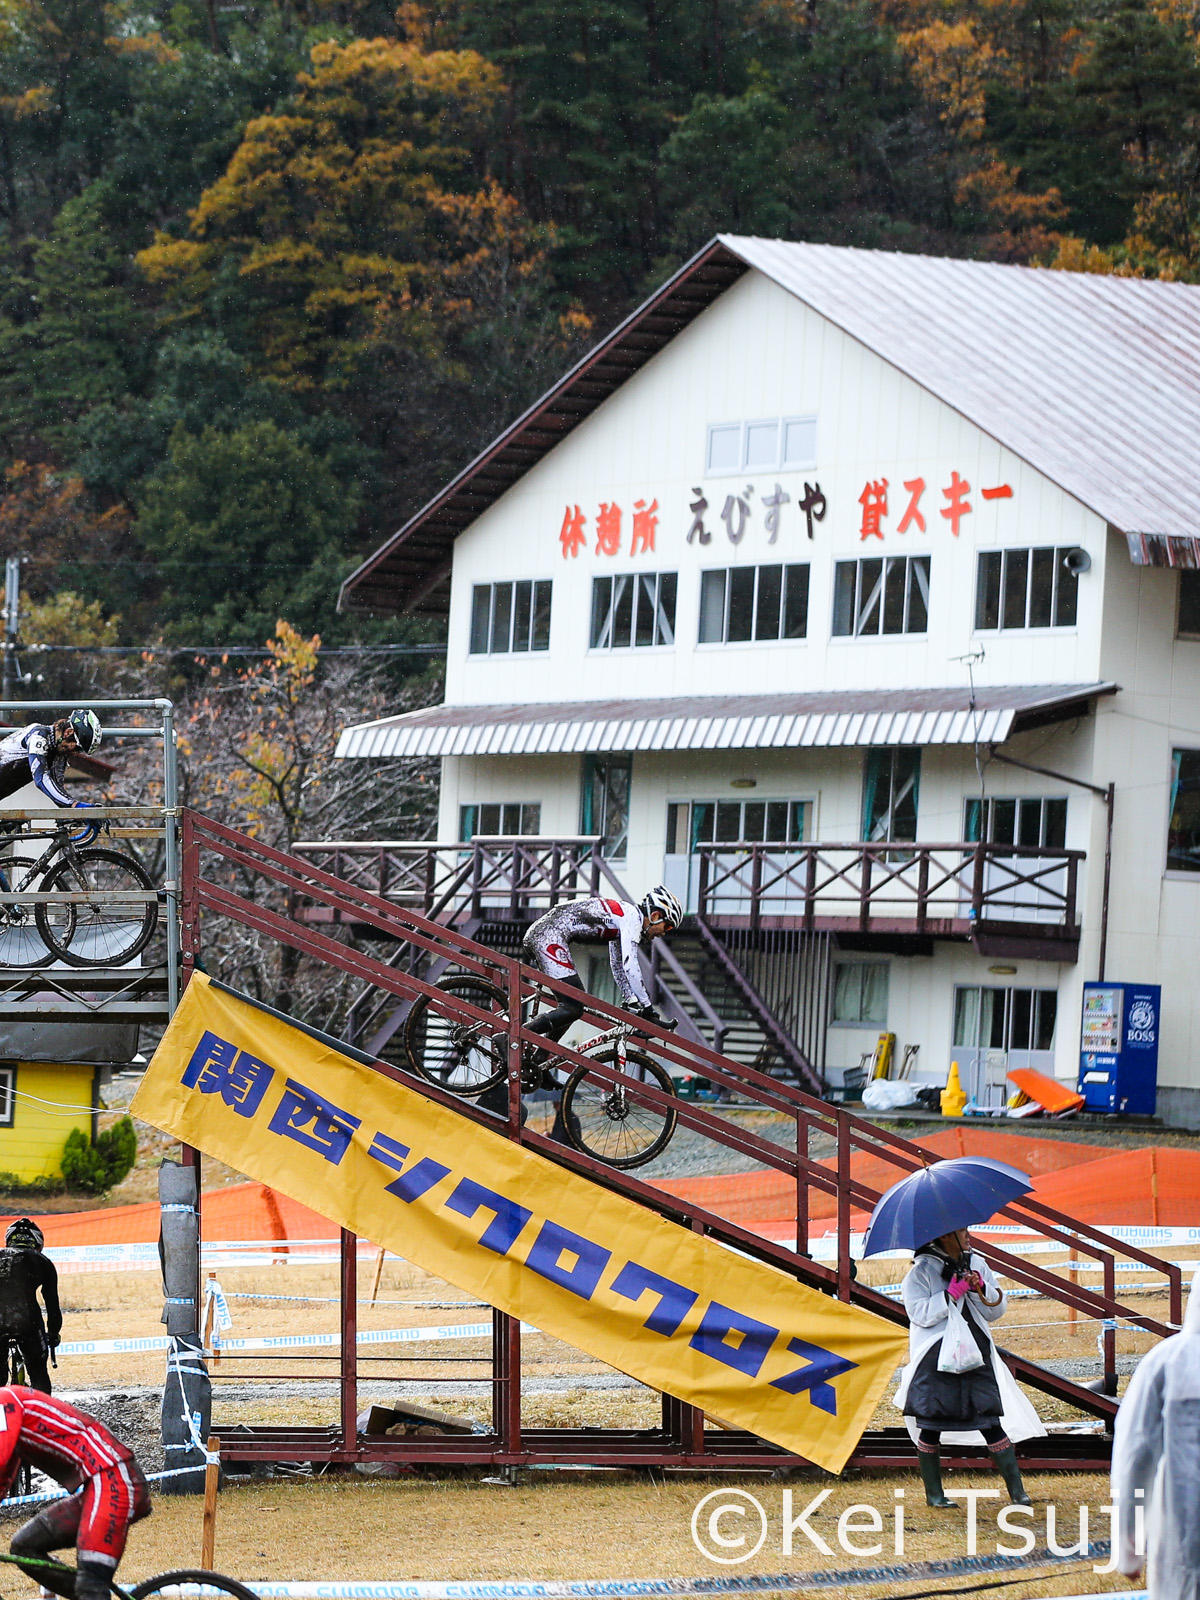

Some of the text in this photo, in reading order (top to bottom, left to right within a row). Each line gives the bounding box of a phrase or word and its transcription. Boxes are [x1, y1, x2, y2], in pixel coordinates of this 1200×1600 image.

[559, 470, 1014, 559] 休憩所 えびすや 貸スキー
[1127, 1029, 1155, 1043] BOSS
[180, 1029, 860, 1416] 関西シクロクロス
[263, 1334, 333, 1347] SHIMANO
